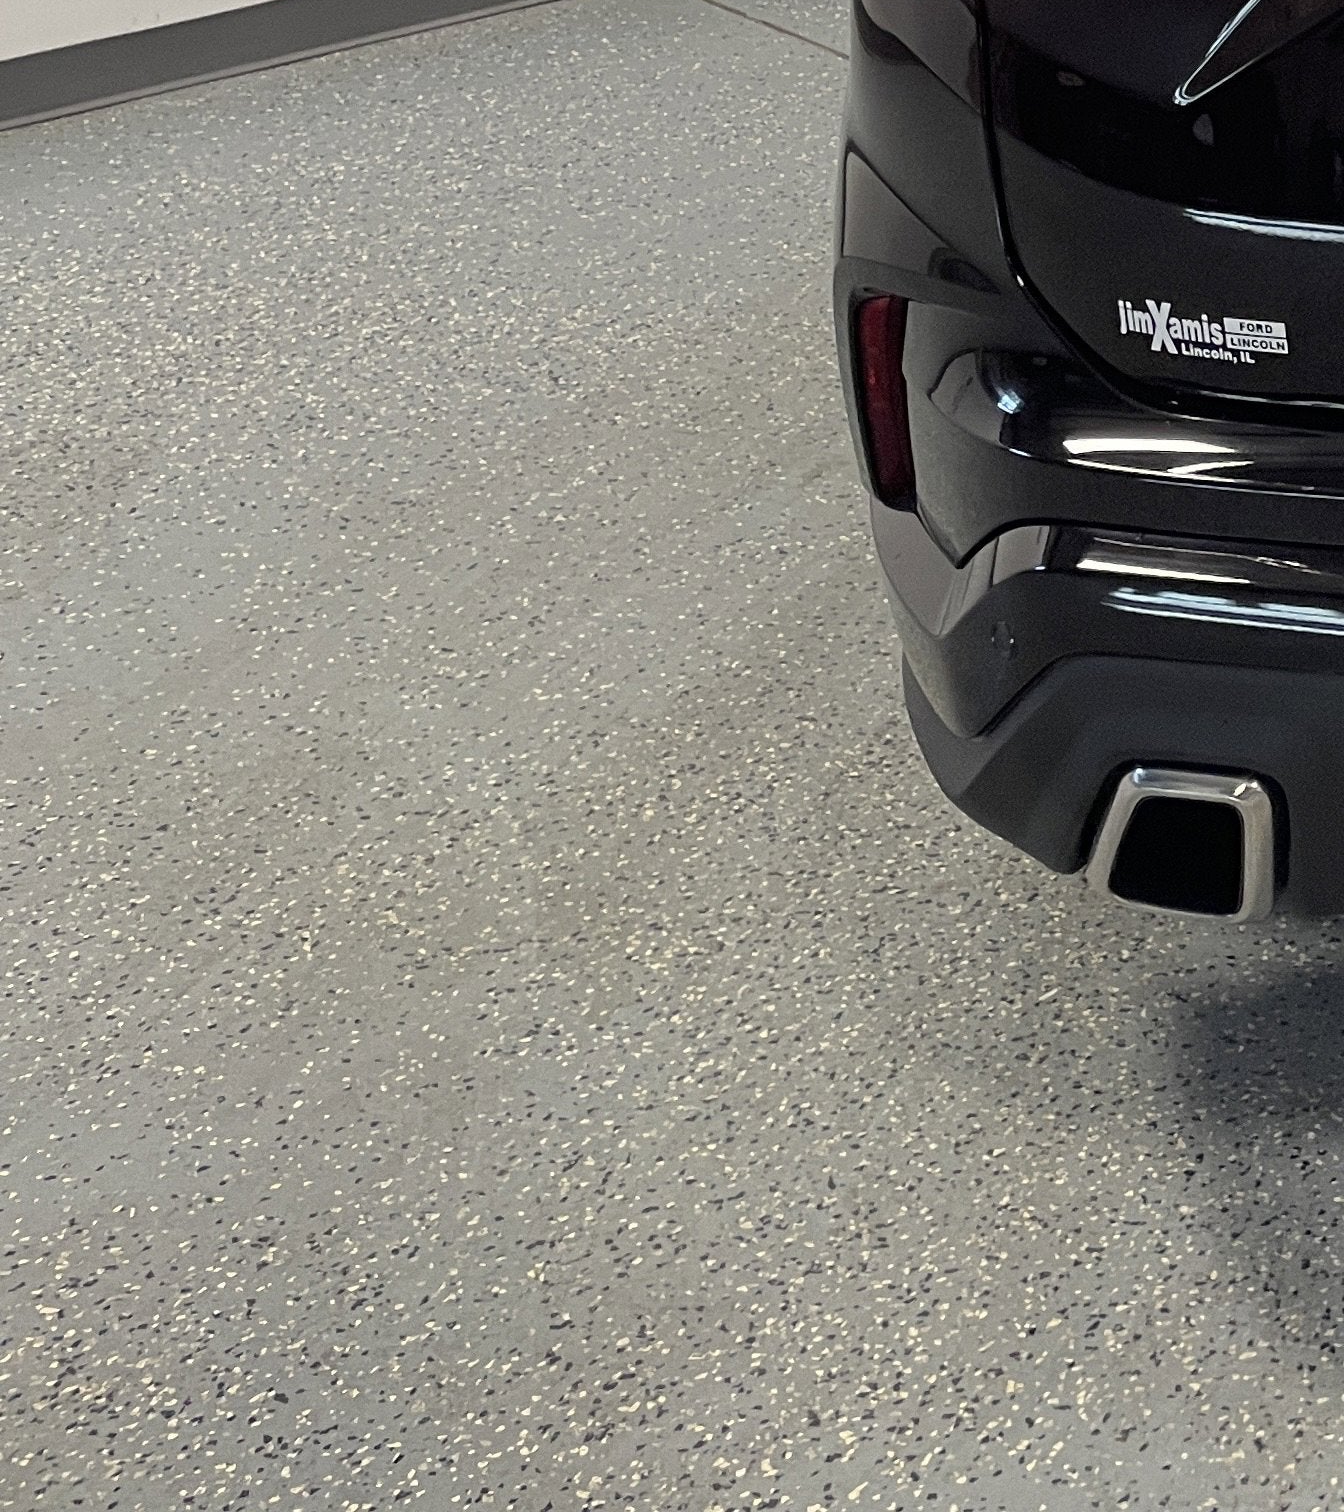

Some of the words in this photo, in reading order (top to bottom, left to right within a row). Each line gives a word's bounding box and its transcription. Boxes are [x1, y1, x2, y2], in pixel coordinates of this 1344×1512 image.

[1239, 321, 1274, 335] FORD
[1230, 337, 1286, 352] LINCOLN
[1181, 341, 1239, 365] Lincoln,
[1240, 351, 1257, 365] IL
